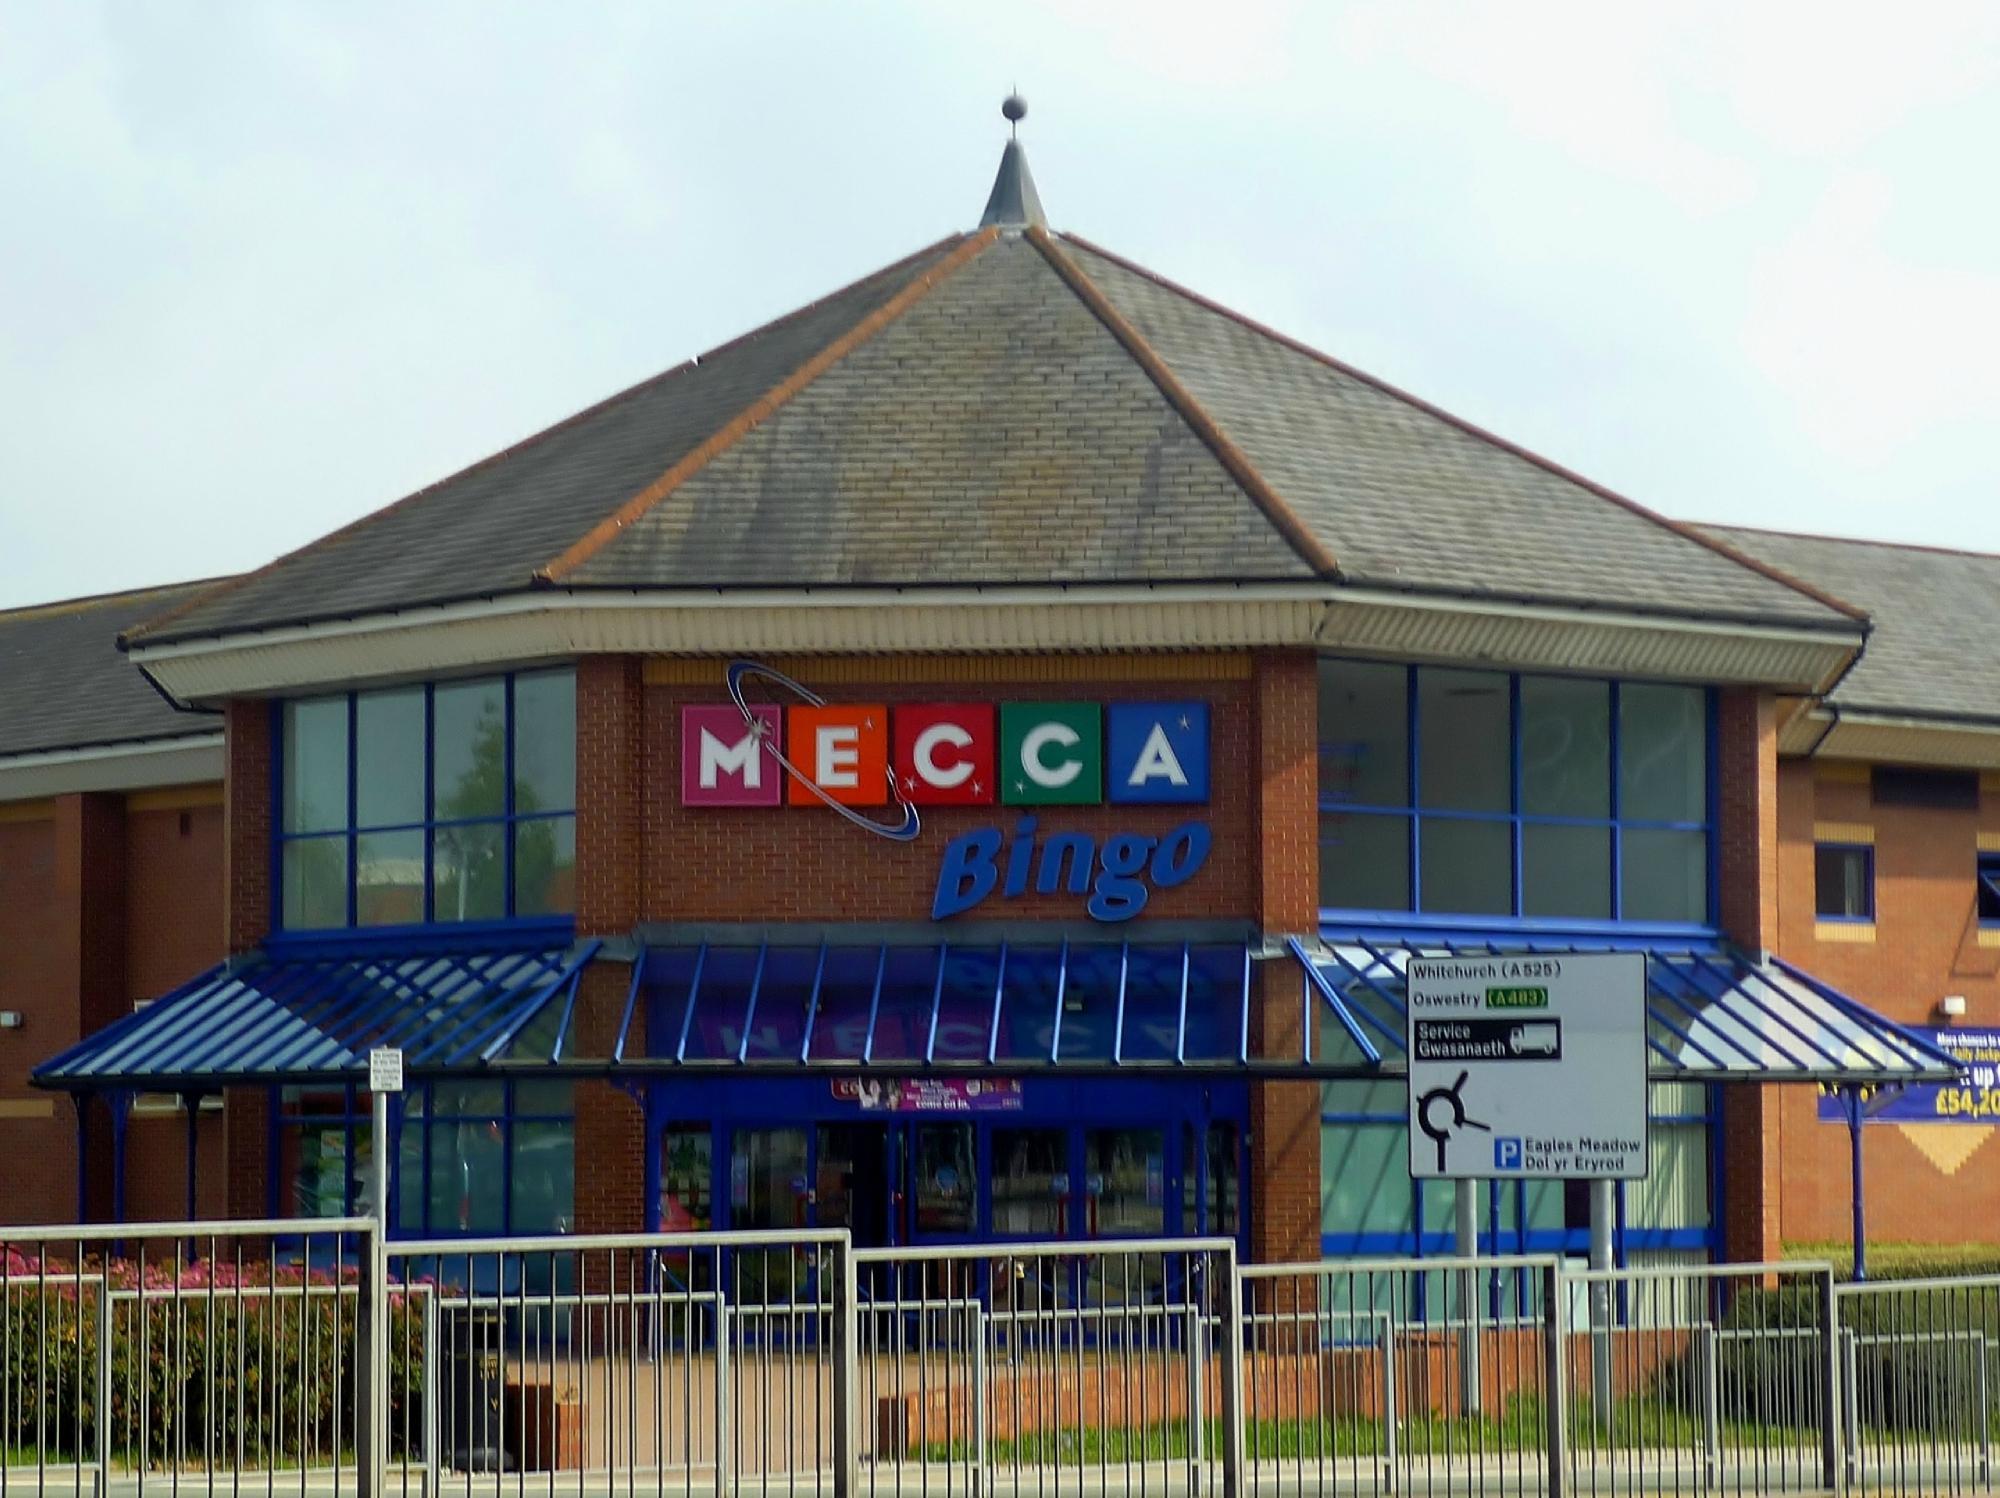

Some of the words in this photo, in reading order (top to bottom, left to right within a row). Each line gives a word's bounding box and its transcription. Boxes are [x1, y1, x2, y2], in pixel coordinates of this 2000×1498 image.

[699, 721, 1189, 789] MECCA
[930, 814, 1213, 922] Bingo
[1413, 962, 1497, 980] Whitchurch
[1502, 959, 1561, 979] (A525)
[1413, 991, 1481, 1008] Oswestry
[1419, 1022, 1471, 1040] Service
[1419, 1039, 1506, 1057] Gwasanaeth
[1973, 1066, 1995, 1090] up
[1501, 1140, 1518, 1168] P
[1525, 1138, 1574, 1155] Eagles
[1579, 1138, 1640, 1152] Meadow
[1554, 1158, 1568, 1172] yr
[1575, 1156, 1625, 1173] Eryrod
